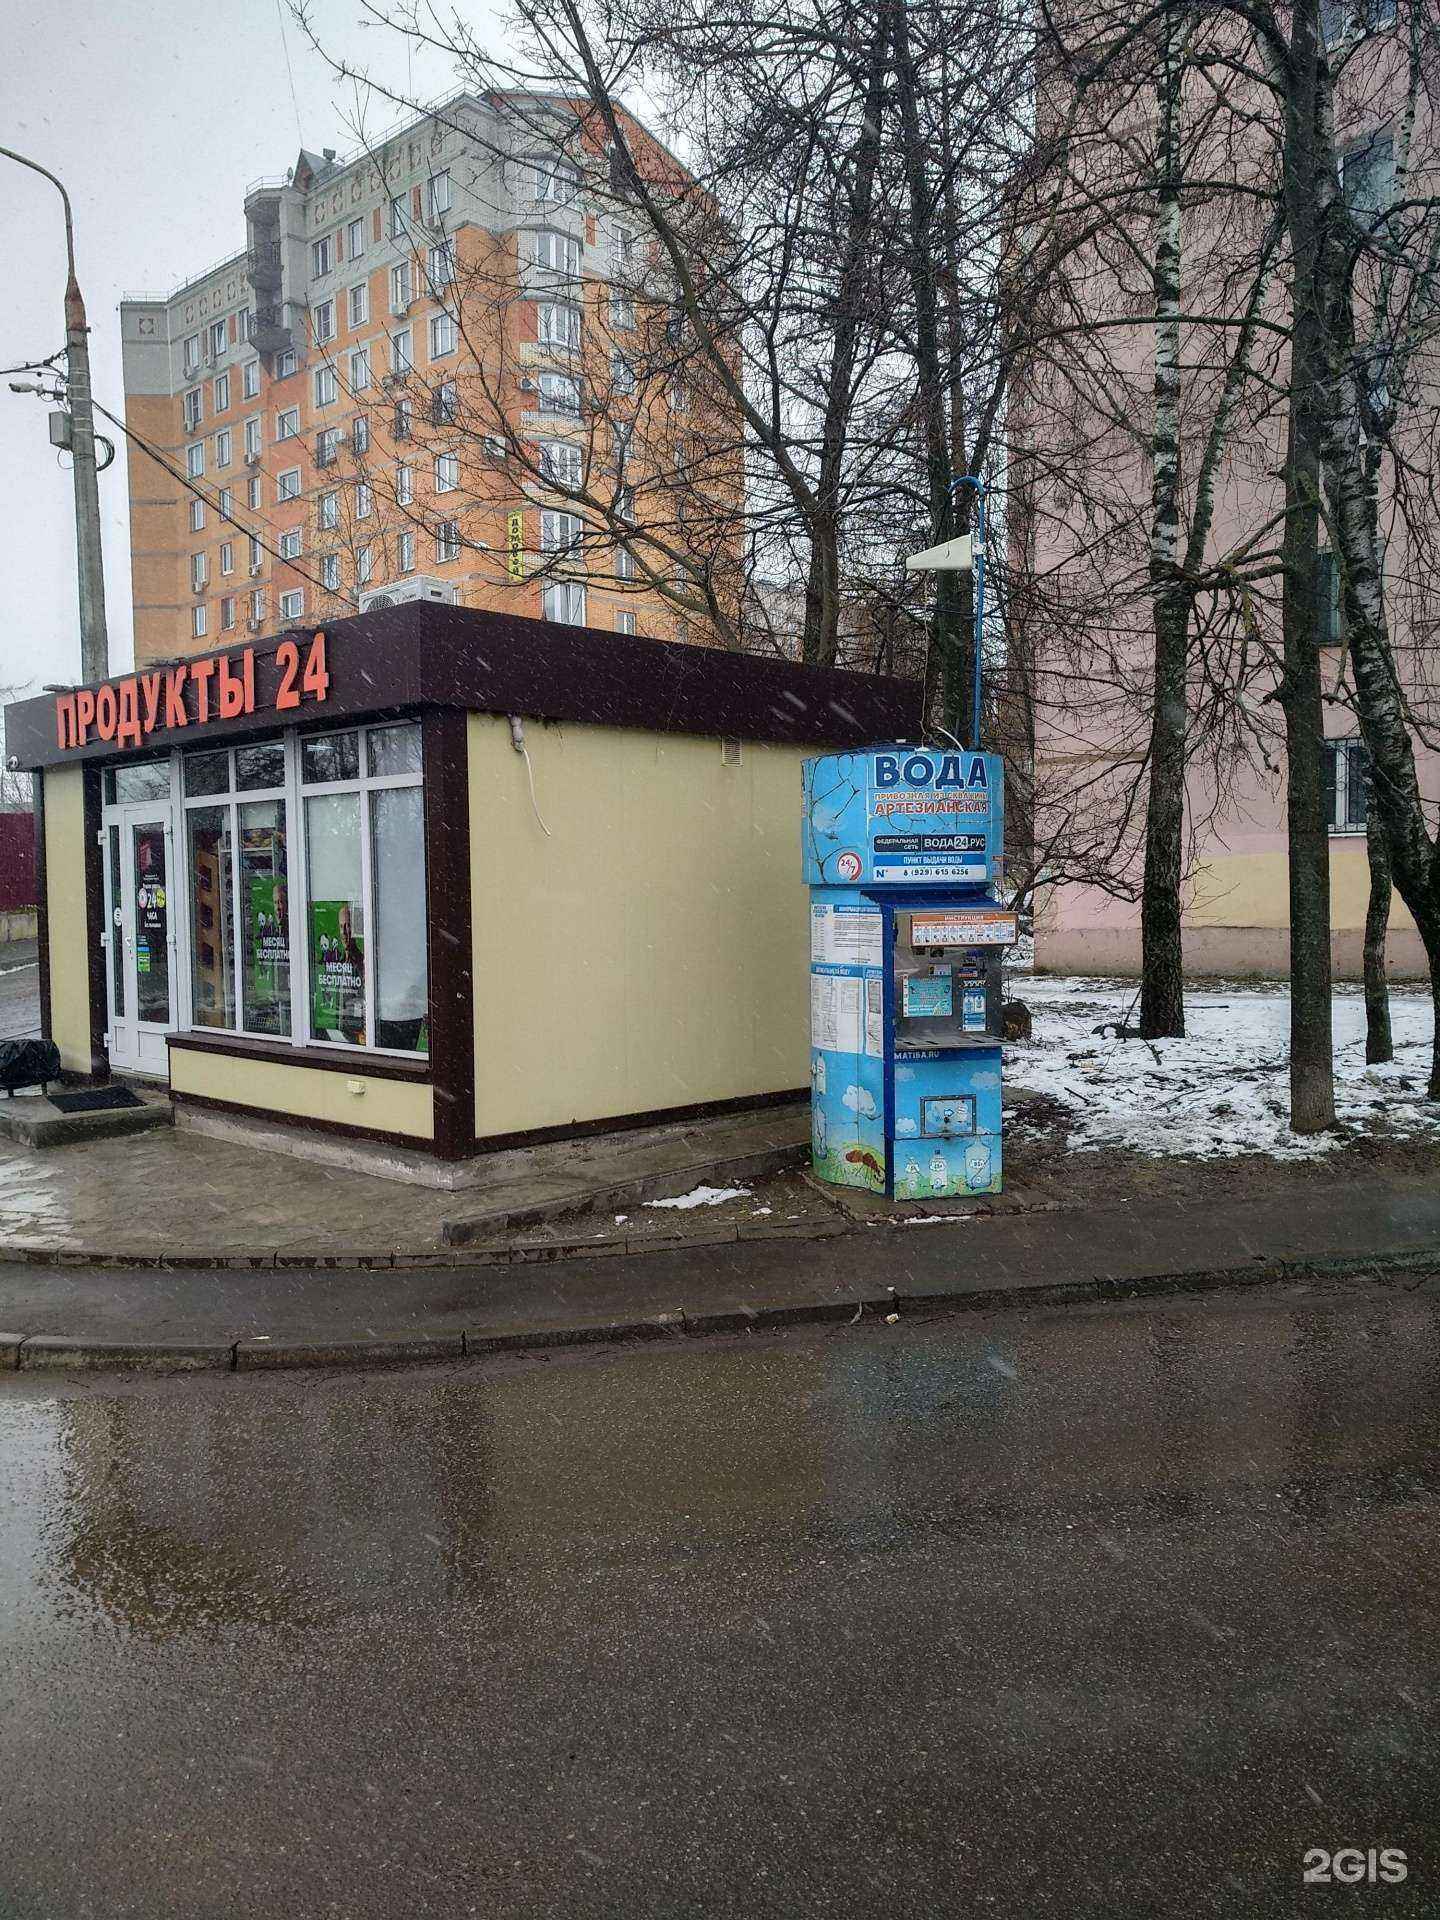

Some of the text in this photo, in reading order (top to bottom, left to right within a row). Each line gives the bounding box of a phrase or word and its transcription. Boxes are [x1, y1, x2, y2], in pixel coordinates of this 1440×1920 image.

[56, 632, 329, 749] ПРОДУКТЫ 24
[873, 754, 988, 790] ВОДА
[874, 791, 930, 801] ПРИВОЗНАЯ
[874, 800, 988, 816] АРТЕЗИАНСКАЯ
[903, 855, 963, 864] ПУНКТ ВЫДАЧИ ВОДЫ
[911, 868, 933, 876] (929)
[935, 868, 949, 876] 615
[951, 868, 969, 876] 6256
[263, 936, 285, 947] МЕСЯЦ
[256, 949, 290, 960] БЕСПЛАТН
[326, 961, 353, 974] МЕСЯЦ
[318, 975, 362, 988] БЕСПЛАТНО
